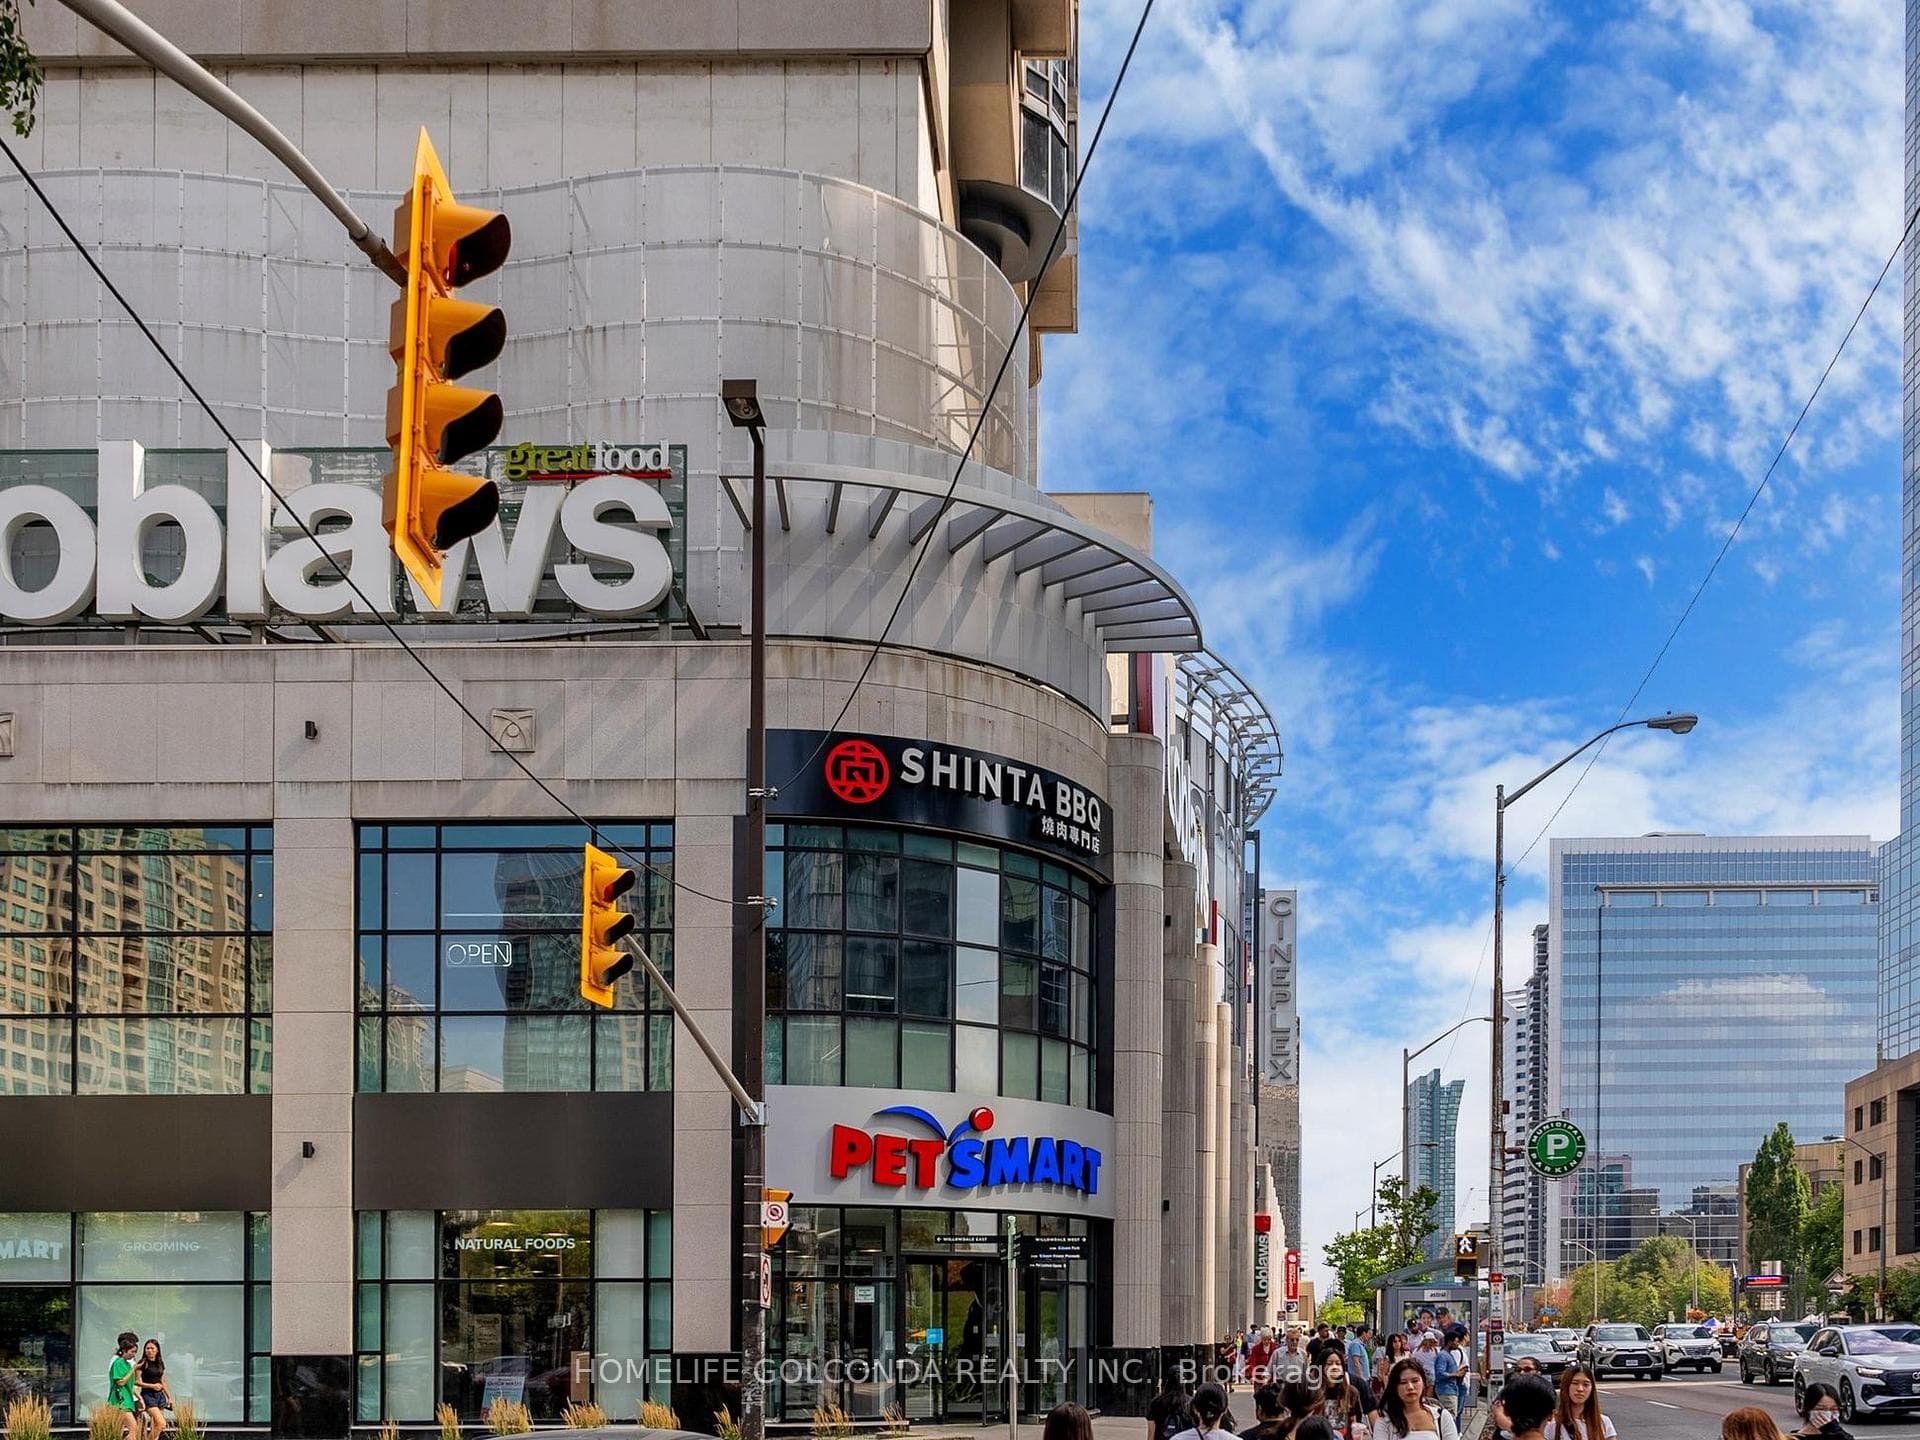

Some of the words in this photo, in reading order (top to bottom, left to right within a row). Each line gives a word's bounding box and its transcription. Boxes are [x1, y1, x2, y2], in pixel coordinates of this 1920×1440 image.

[900, 747, 1047, 810] SHINTA
[1056, 782, 1101, 832] BBQ
[1041, 815, 1100, 855] 燒肉專門店
[448, 944, 509, 965] OPEN
[1270, 896, 1292, 1080] CINEPLEX
[1531, 1121, 1583, 1143] MUNICIPAL
[1546, 1134, 1570, 1156] P
[1530, 1152, 1584, 1174] PARKING
[122, 1241, 200, 1252] GROOMING
[454, 1237, 522, 1250] NATURAL
[525, 1237, 576, 1250] FOODS
[1255, 1234, 1270, 1298] Loblaws
